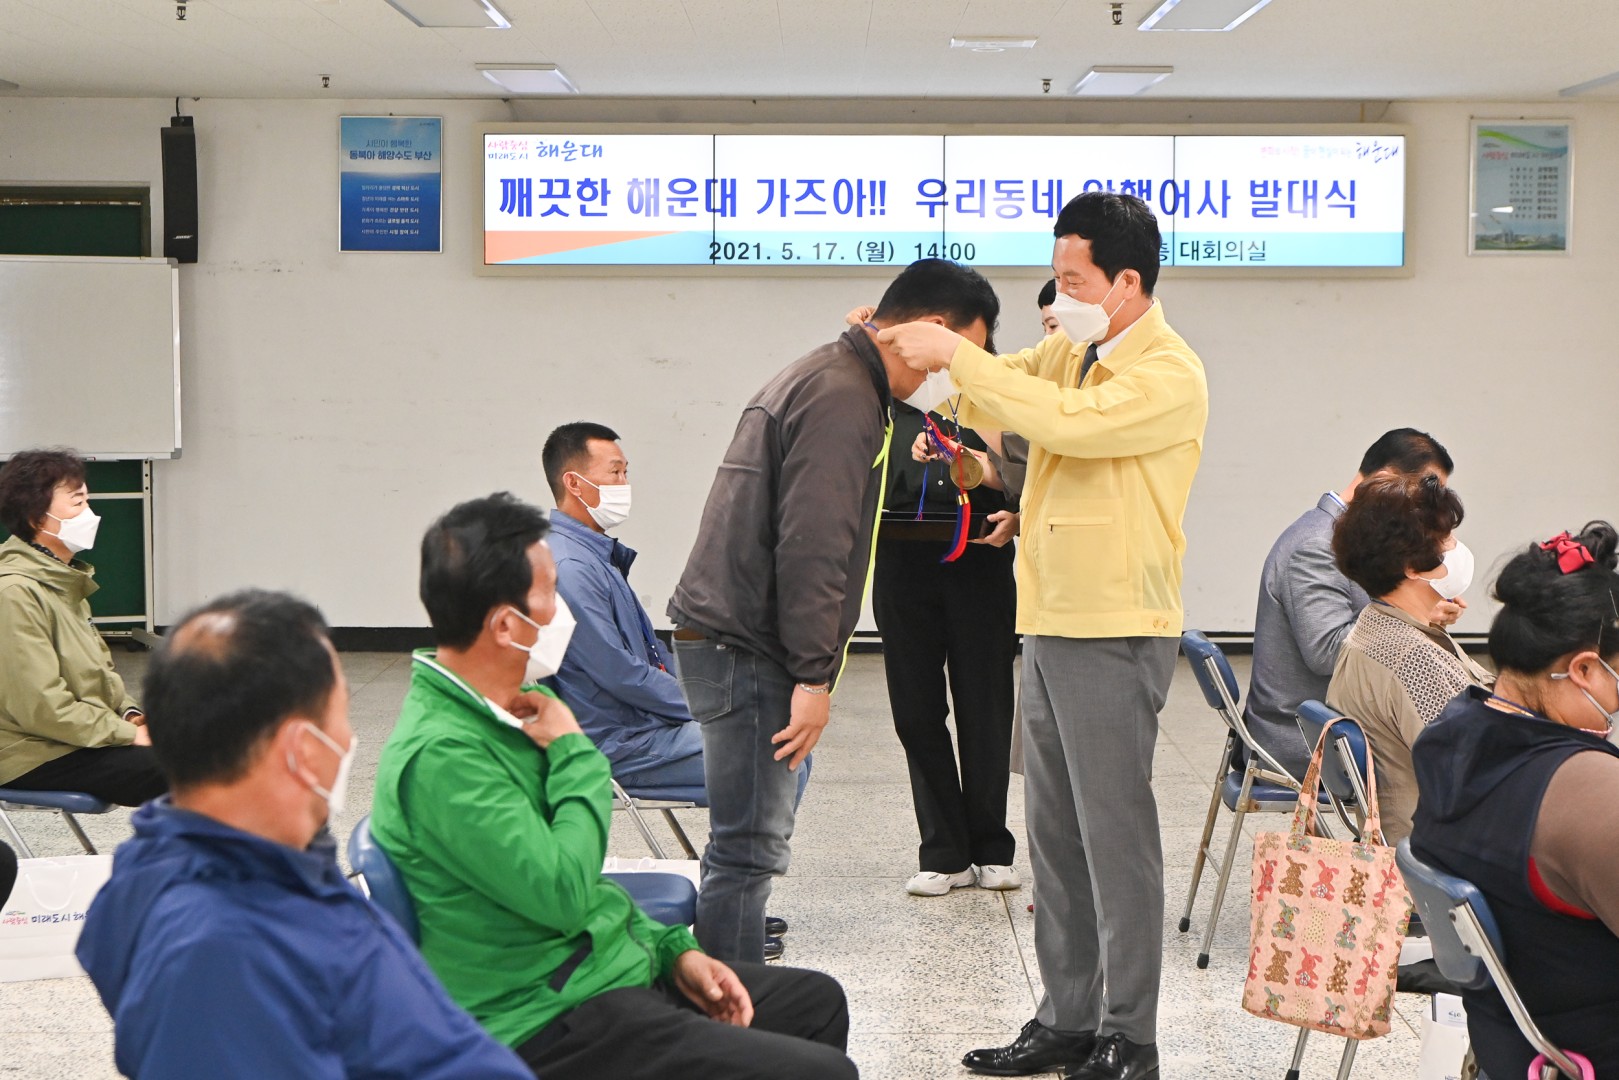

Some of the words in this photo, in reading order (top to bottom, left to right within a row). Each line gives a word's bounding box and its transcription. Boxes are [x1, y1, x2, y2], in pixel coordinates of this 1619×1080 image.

[349, 150, 375, 160] 동북아
[377, 150, 412, 161] 해양수도
[414, 150, 432, 161] 부산
[488, 152, 528, 160] 미래도시
[536, 140, 603, 162] 해운대
[1355, 140, 1400, 164] 해운대
[498, 177, 612, 218] 깨끗한
[627, 177, 737, 218] 해운대
[756, 178, 887, 218] 가즈아!!
[916, 178, 1063, 219] 우리동네
[1249, 178, 1356, 219] 발대식
[709, 242, 771, 260] 2021.
[781, 242, 801, 260] 5.
[812, 242, 845, 260] 17.
[857, 241, 895, 262] (월)
[914, 242, 976, 260] 14:00
[1180, 241, 1266, 262] 대회의실
[31, 913, 71, 923] 미래도시
